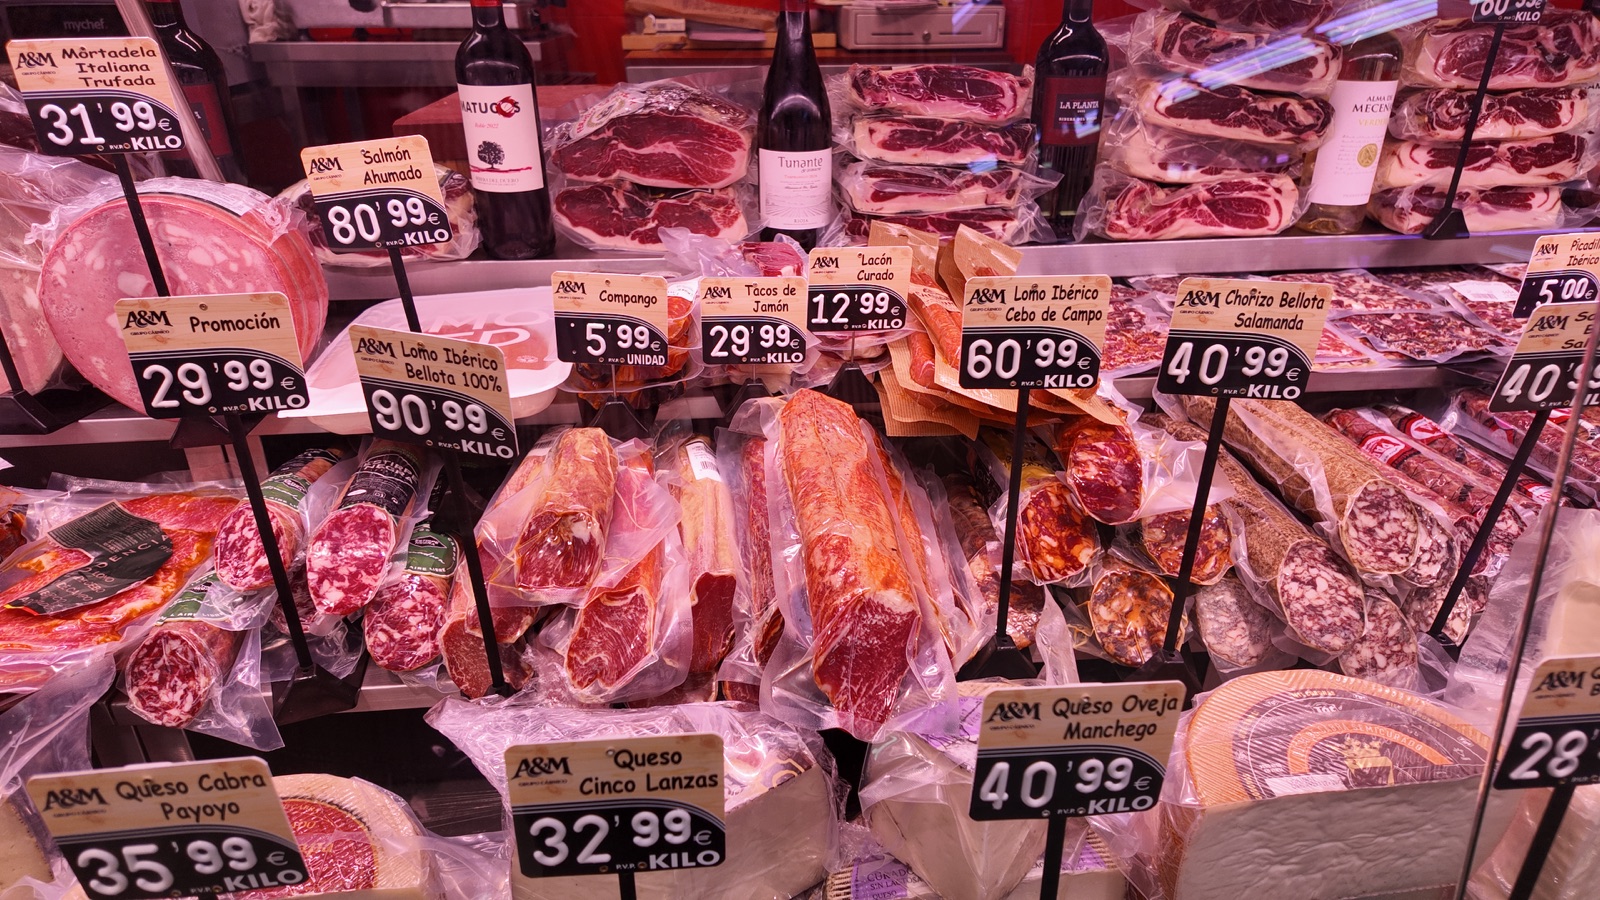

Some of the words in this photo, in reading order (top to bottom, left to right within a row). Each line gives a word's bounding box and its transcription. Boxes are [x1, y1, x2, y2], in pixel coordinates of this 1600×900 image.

[1514, 12, 1541, 21] KILO
[16, 52, 58, 70] A&M
[61, 47, 157, 60] Mortadela
[77, 62, 151, 73] Italiana
[79, 76, 156, 87] Trufada
[1059, 101, 1071, 109] LA
[131, 135, 182, 151] KILO
[363, 146, 412, 165] Salmón
[778, 156, 823, 168] Tunante
[308, 157, 344, 176] A&M
[363, 165, 423, 185] Ahumado
[404, 229, 450, 246] KILO
[810, 256, 840, 269] A&M
[861, 253, 892, 266] Lacón
[1567, 254, 1600, 266] Ibérico
[857, 269, 894, 281] Curado
[555, 281, 587, 295] A&M
[703, 286, 732, 300] A&M
[745, 284, 778, 296] Tacos
[782, 284, 796, 296] de
[966, 288, 1007, 306] A&M
[1014, 286, 1046, 301] Lomo
[1051, 284, 1099, 300] Ibérico
[599, 290, 657, 308] Compango
[753, 300, 789, 313] Jamón
[1177, 290, 1221, 308] A&M
[1225, 289, 1274, 307] Chorizo
[1279, 291, 1325, 309] Bellota
[123, 310, 173, 330] A&M
[189, 312, 281, 333] Promoción
[867, 319, 903, 330] KILO
[1005, 307, 1036, 322] Cebo
[1041, 306, 1057, 321] de
[1062, 307, 1103, 325] Campo
[1234, 312, 1304, 331] Salamanda
[1527, 315, 1569, 333] A&M
[355, 337, 398, 359] A&M
[400, 341, 438, 362] Lomo
[443, 347, 498, 371] Ibérico
[627, 354, 665, 365] UNIDAD
[767, 352, 804, 363] KILO
[405, 363, 456, 385] Bellota
[462, 372, 503, 392] 100%
[1044, 374, 1094, 387] KILO
[1247, 384, 1301, 400] KILO
[248, 394, 306, 412] KILO
[461, 439, 514, 459] KILO
[1533, 671, 1587, 693] A&M
[984, 702, 1042, 723] A&M
[1052, 697, 1112, 719] Queso
[1122, 693, 1178, 717] Oveja
[1063, 719, 1157, 741] Manchego
[511, 756, 573, 780] A&M
[613, 748, 682, 771] Queso
[115, 779, 188, 802] Queso
[198, 771, 267, 792] Cabra
[579, 777, 636, 796] Cinco
[646, 773, 718, 792] Lanzas
[43, 787, 110, 811] A&M
[1087, 795, 1153, 814] KILO
[160, 801, 240, 822] Payoyo
[649, 850, 720, 870] KILO
[223, 869, 303, 892] KILO
